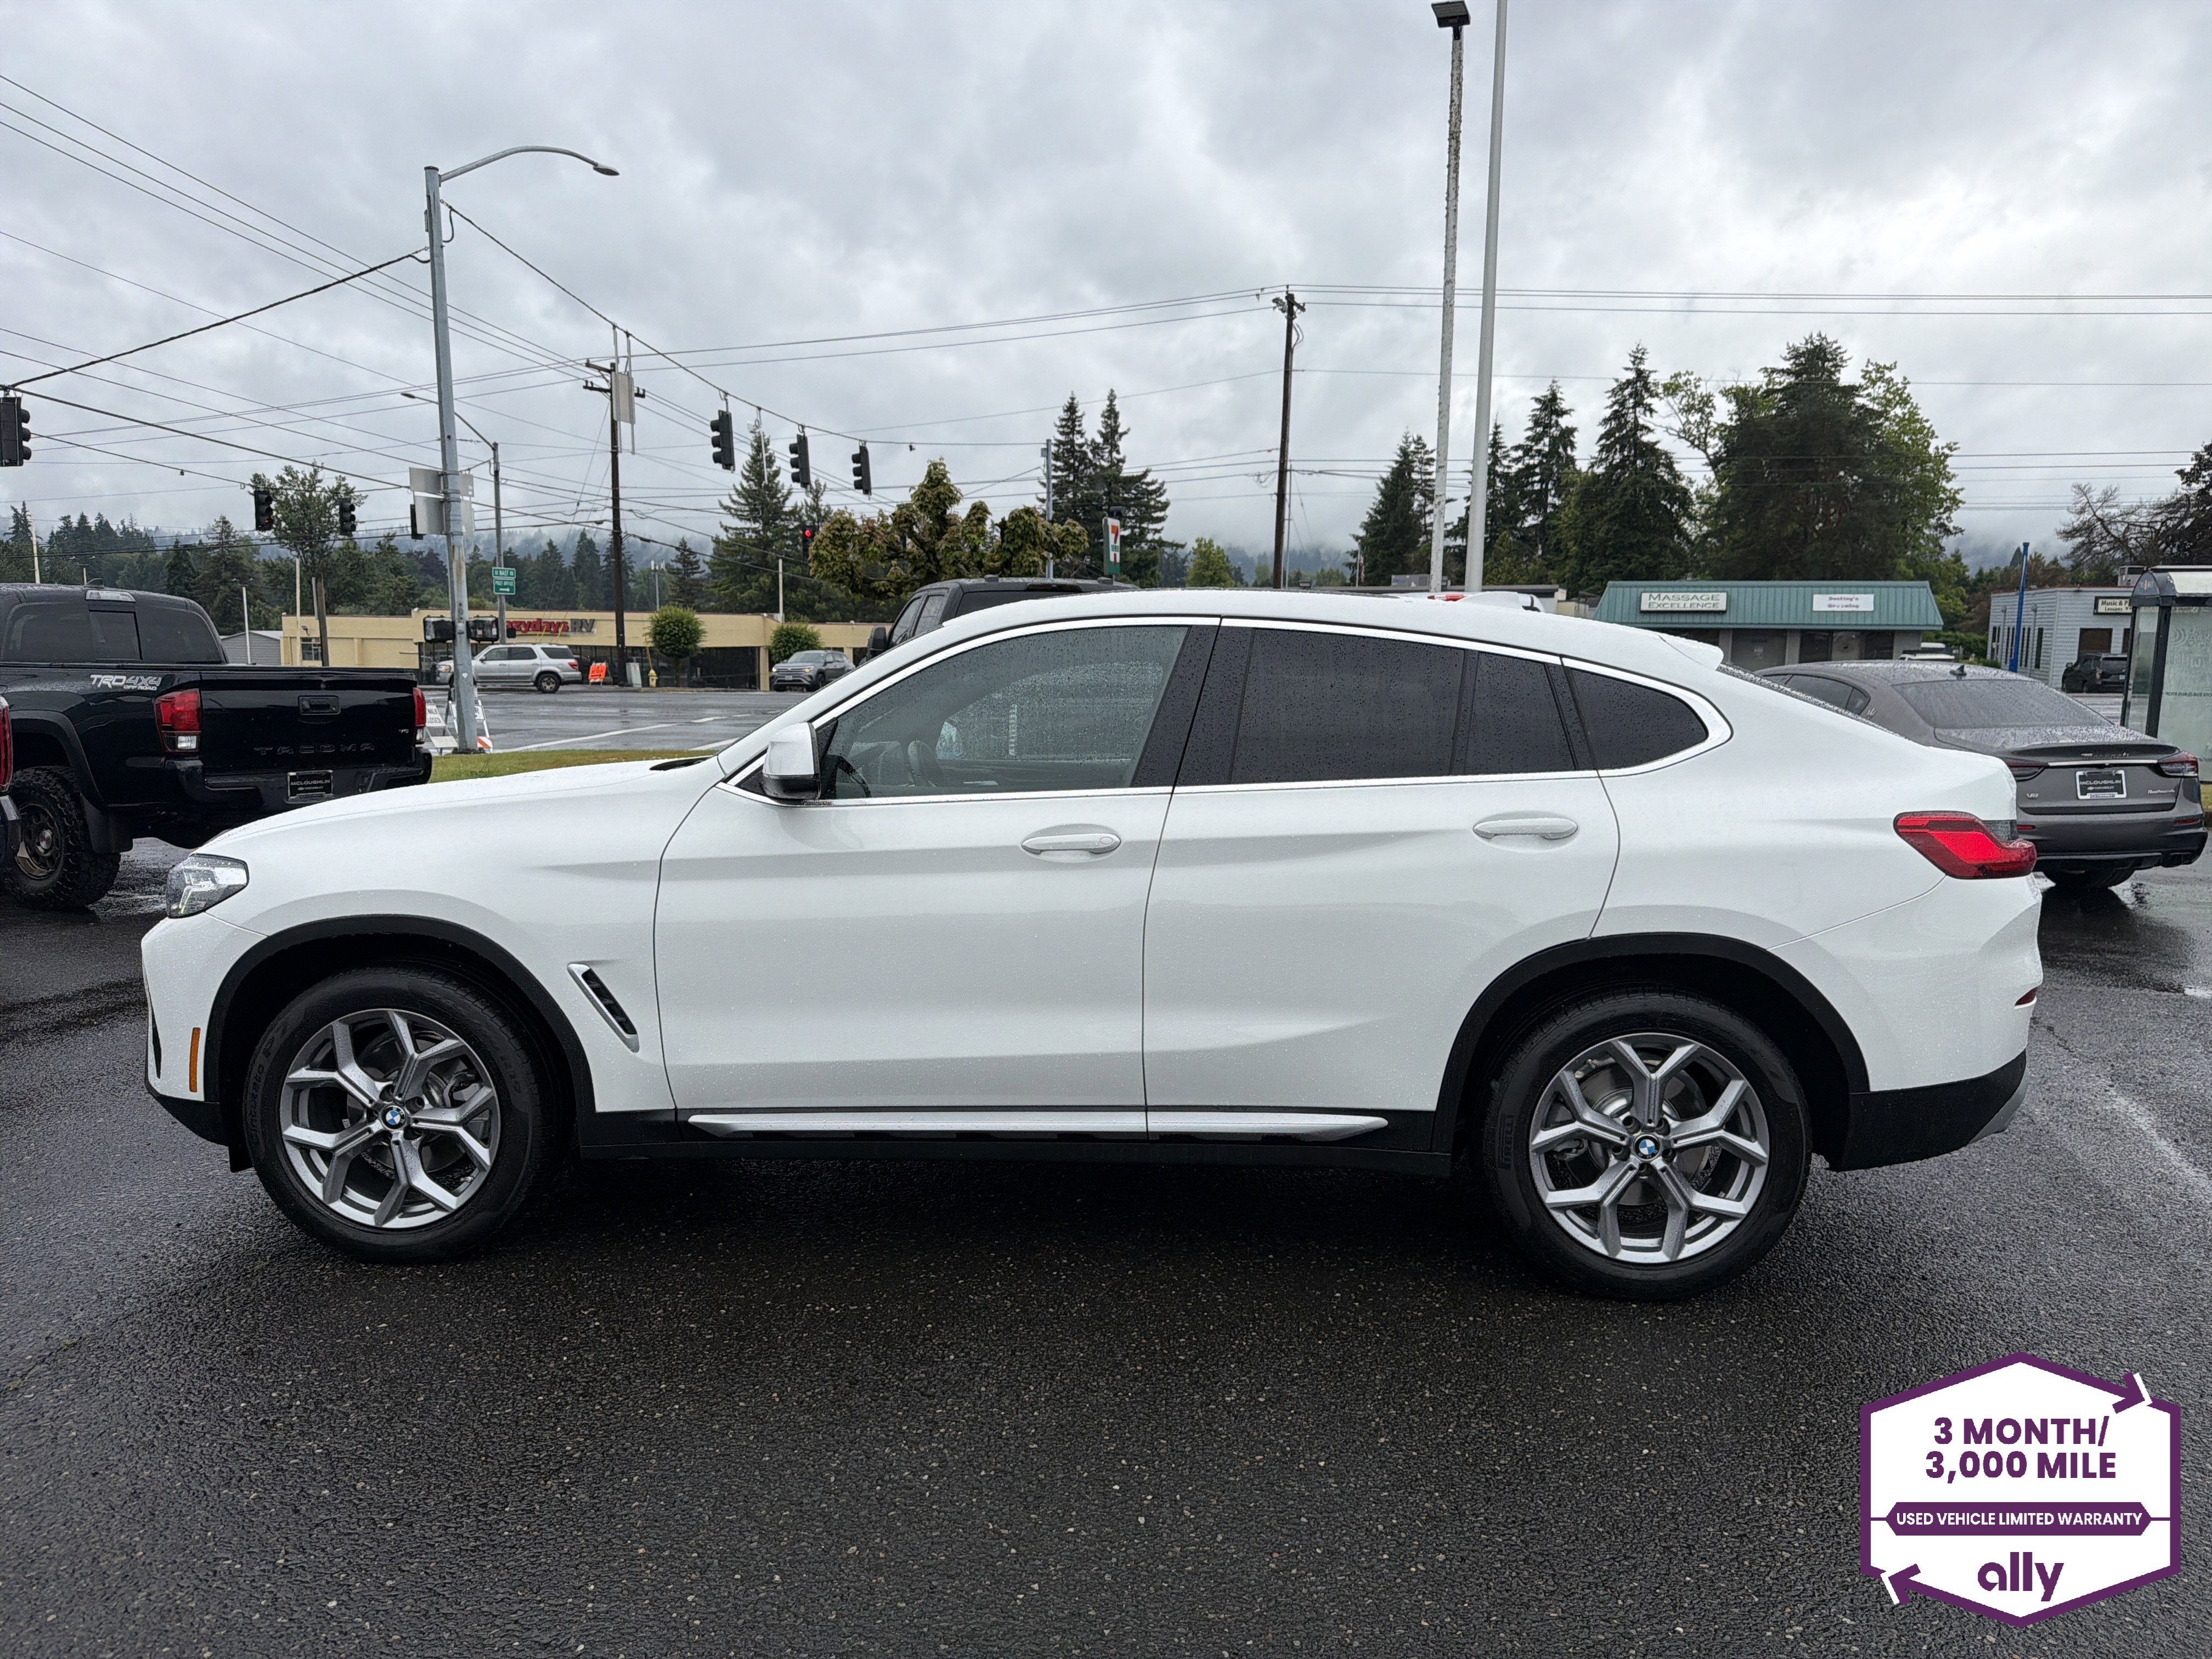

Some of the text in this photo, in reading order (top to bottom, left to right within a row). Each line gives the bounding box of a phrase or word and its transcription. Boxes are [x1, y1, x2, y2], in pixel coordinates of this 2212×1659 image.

[571, 619, 595, 633] RV
[90, 674, 126, 689] TRD
[253, 743, 375, 755] TACOMA
